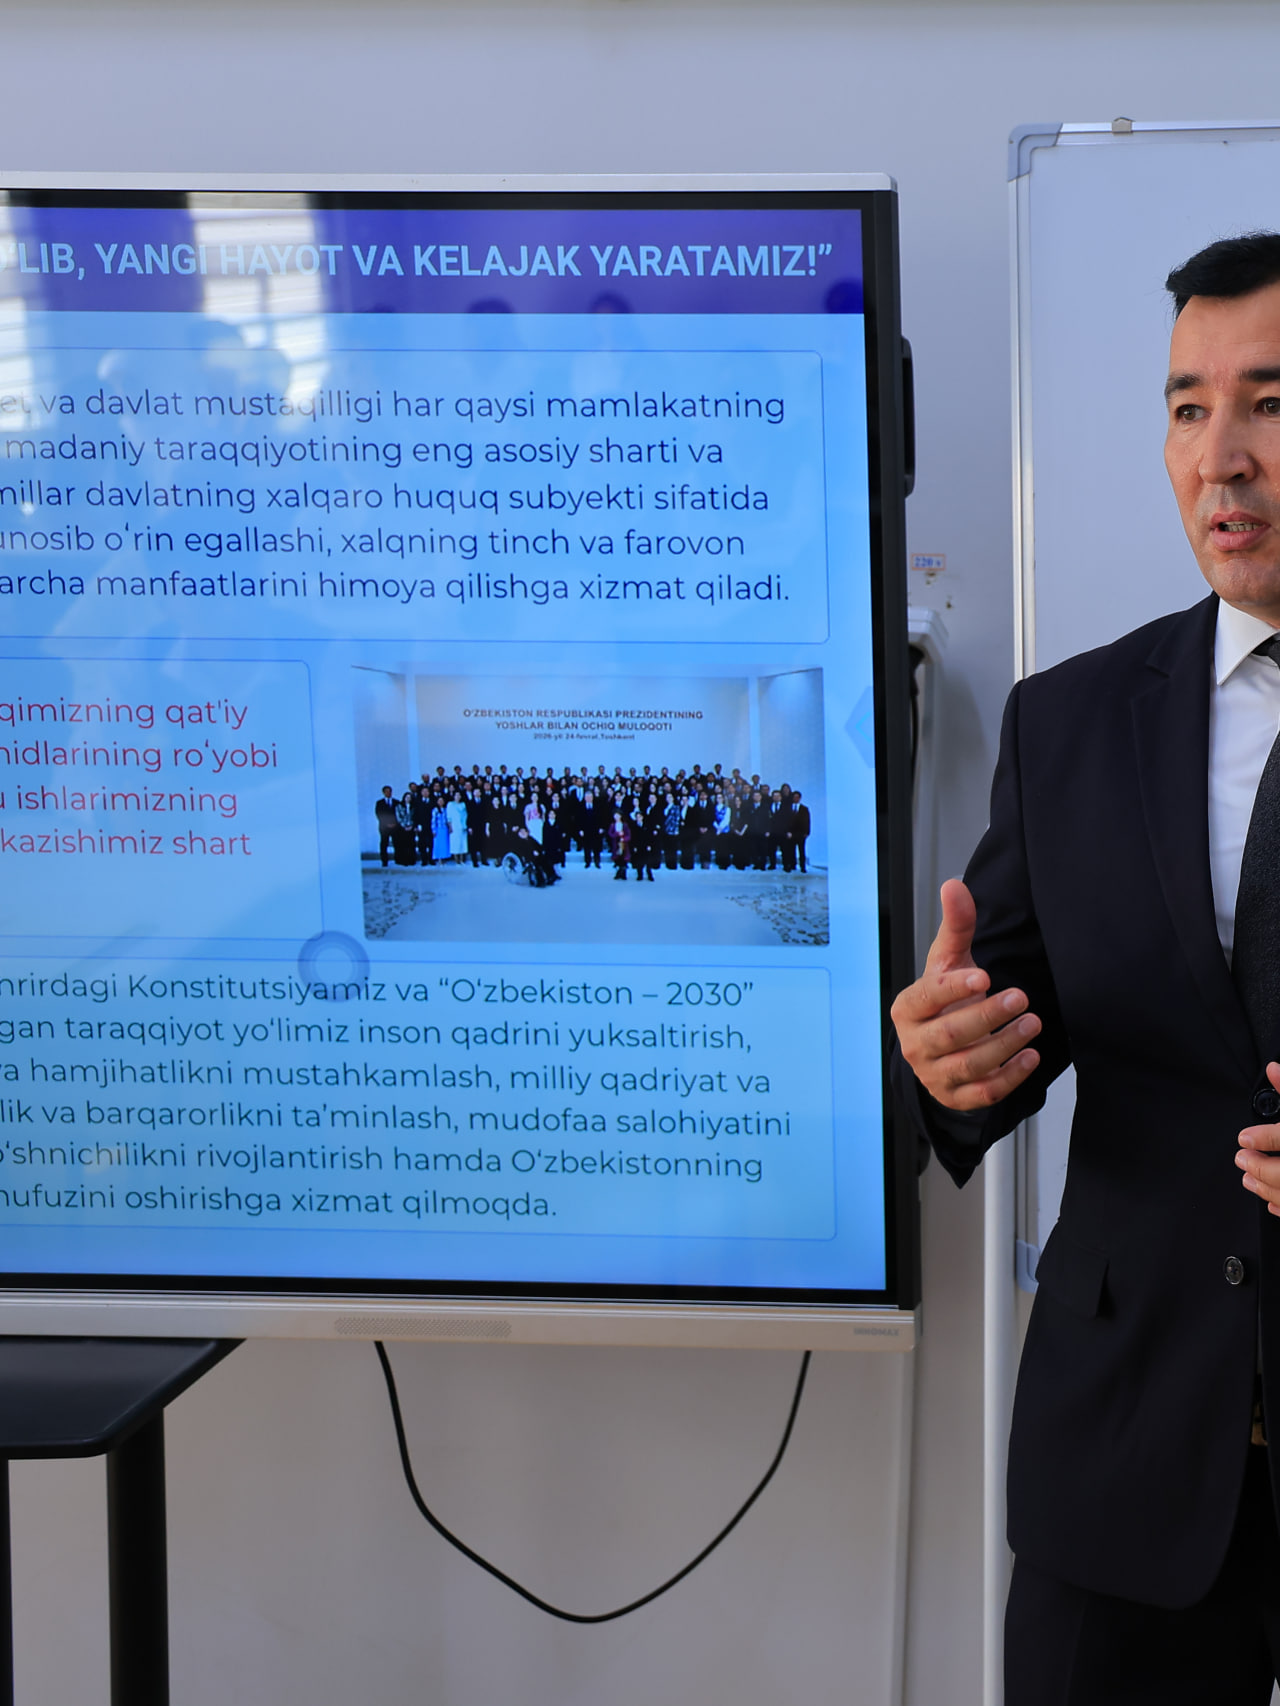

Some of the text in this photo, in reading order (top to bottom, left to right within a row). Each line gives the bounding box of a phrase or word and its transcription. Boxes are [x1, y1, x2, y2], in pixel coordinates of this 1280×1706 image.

[94, 242, 207, 276] YANGI
[220, 244, 343, 276] HAYOT
[352, 244, 404, 277] VA
[414, 245, 581, 276] KELAJAK
[39, 394, 75, 415] va
[86, 388, 183, 415] davlat
[194, 390, 381, 423] mustaqilligi
[393, 390, 445, 417] har
[455, 390, 534, 423] qaysi
[547, 391, 784, 424] mamlakatning
[6, 433, 723, 469] madaniy taraqqiyotining eng asosiy sharti va
[86, 480, 255, 514] davlatning
[267, 481, 383, 514] xalqaro
[394, 482, 498, 515] huquq
[509, 483, 643, 516] subyekti
[654, 484, 768, 510] sifatida
[185, 526, 331, 558] egallashi,
[341, 527, 477, 560] xalqning
[488, 528, 569, 554] tinch
[579, 536, 613, 555] va
[624, 528, 744, 555] farovon
[97, 570, 307, 597] manfaatlarini
[319, 571, 435, 604] himoya
[446, 572, 568, 605] qilishga
[580, 573, 686, 600] xizmat
[696, 574, 789, 606] qiladi.
[496, 721, 672, 732] YOSHLAR BILAN OCHIQ MULOQOTI
[536, 709, 612, 719] RESPUBLIKASI
[615, 710, 703, 720] PREZIDENTINING
[17, 785, 236, 818] ishlarimizning
[1, 828, 251, 855] kazishimiz shart
[129, 974, 387, 1006] Konstitutsiyamiz
[395, 984, 428, 1002] va
[666, 981, 753, 1006] 2030”
[64, 1016, 224, 1046] taraqqiyot
[359, 1018, 441, 1044] inson
[451, 1020, 559, 1050] qadrini
[569, 1022, 751, 1053] yuksaltirish,
[31, 1057, 232, 1088] hamjihatlikni
[244, 1062, 500, 1093] mustahkamlash,
[511, 1065, 592, 1096] milliy
[600, 1067, 728, 1098] qadriyat
[737, 1075, 770, 1093] va
[42, 1106, 75, 1124] va
[86, 1100, 282, 1130] barqarorlikni
[469, 1107, 606, 1132] mudofaa
[617, 1109, 790, 1140] salohiyatini
[197, 1143, 382, 1174] rivojlantirish
[394, 1146, 501, 1172] hamda
[125, 1185, 281, 1216] oshirishga
[292, 1188, 393, 1213] xizmat
[403, 1190, 556, 1221] qilmoqda.
